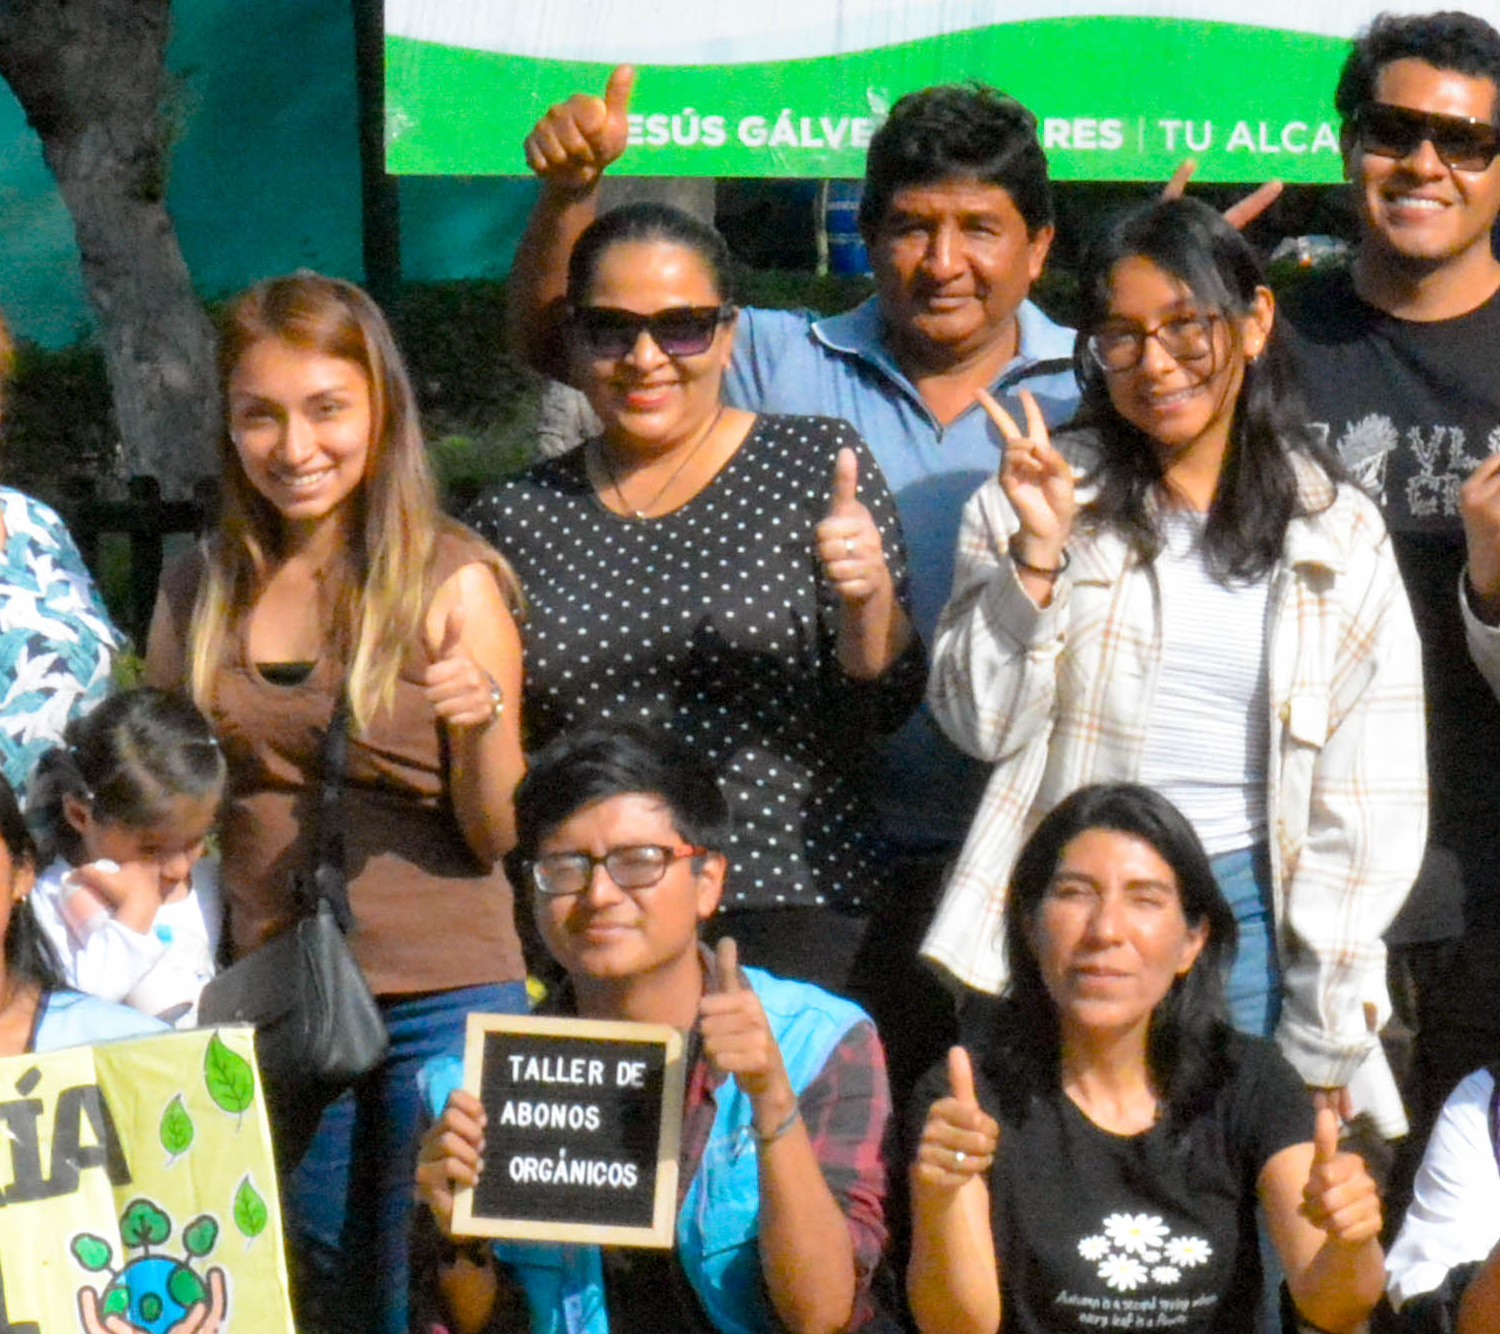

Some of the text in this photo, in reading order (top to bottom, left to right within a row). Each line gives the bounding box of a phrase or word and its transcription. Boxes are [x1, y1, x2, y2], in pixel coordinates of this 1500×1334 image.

[626, 107, 876, 150] ESÚS GÁLVE
[1158, 120, 1212, 152] TU
[508, 1055, 646, 1088] TALLER DE
[500, 1100, 601, 1130] ABONOS
[508, 1147, 639, 1189] ORGÁNICOS
